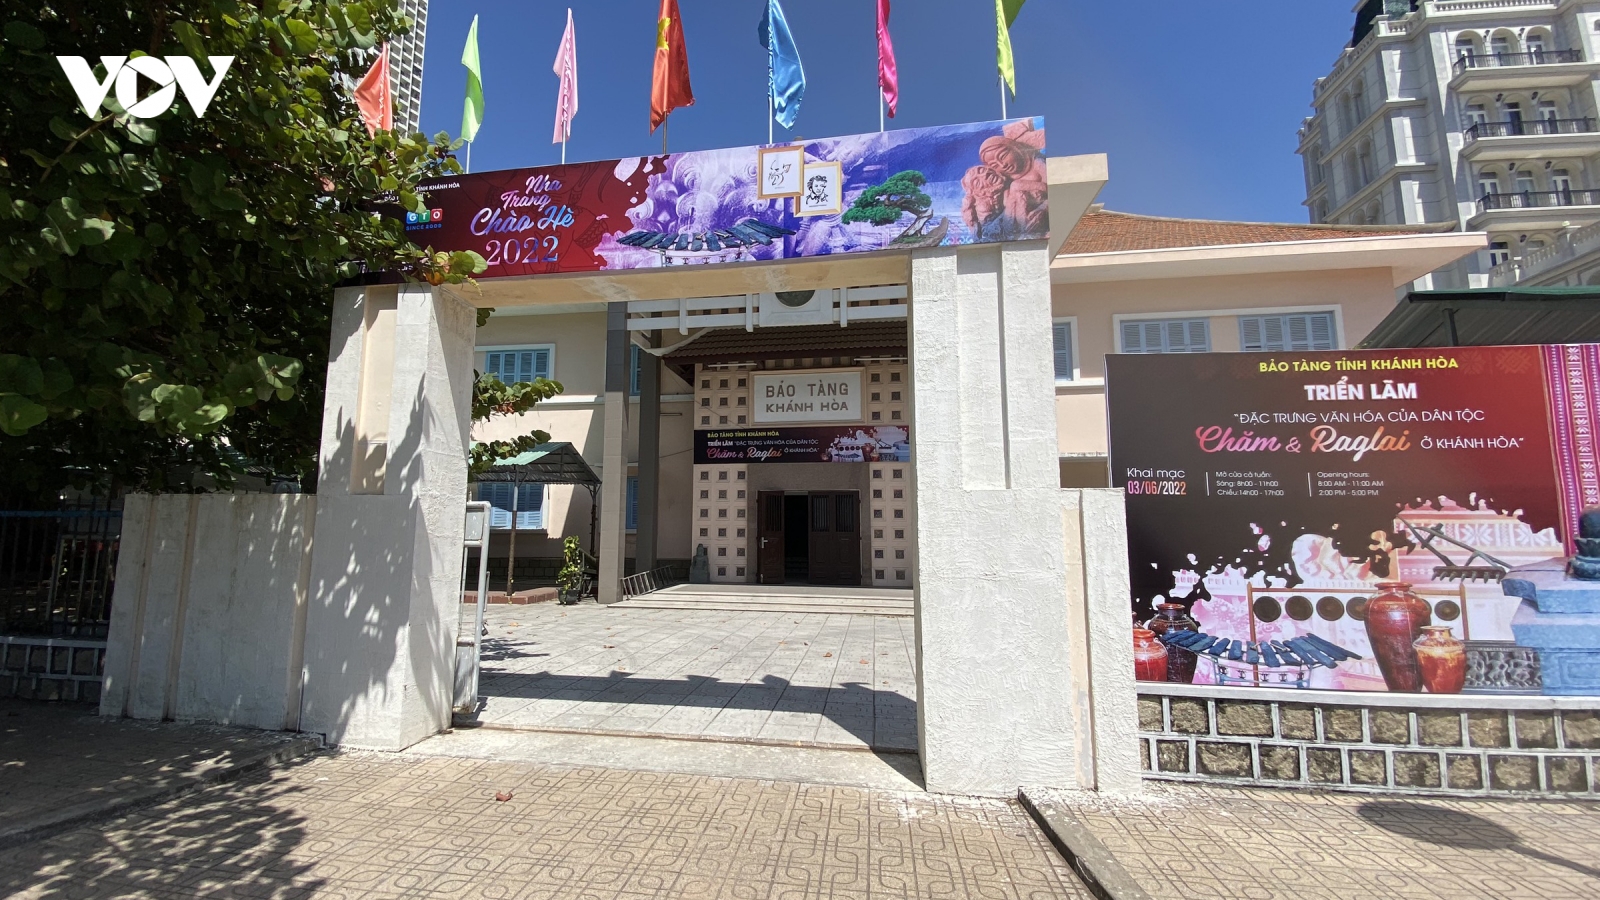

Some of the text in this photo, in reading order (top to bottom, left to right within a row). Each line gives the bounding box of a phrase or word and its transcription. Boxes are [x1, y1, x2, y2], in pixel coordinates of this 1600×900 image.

[525, 174, 562, 194] Nha
[500, 190, 551, 212] Trang
[470, 204, 575, 236] Chào Hè
[485, 235, 559, 266] 2022
[1259, 355, 1459, 372] BẢO TÀNG TỈNH KHÁNH HÒA
[807, 379, 849, 397] TÀNG
[1304, 375, 1418, 401] TRIỂN LÃM
[766, 398, 849, 413] KHÁNH HÒA
[1273, 412, 1317, 423] TRƯNG
[1320, 410, 1350, 423] VĂN
[1353, 409, 1385, 423] HÓA
[1388, 408, 1419, 422] CỦA
[1422, 409, 1453, 422] DÂN
[1455, 408, 1485, 423] TỘC
[1195, 425, 1282, 453] Chăm
[1285, 436, 1302, 453] &
[1310, 425, 1411, 462] Raglai
[1420, 435, 1434, 449] Ở
[1436, 436, 1484, 449] KHÁNH
[706, 447, 737, 459] Chăm
[746, 446, 783, 462] Raglai
[1126, 467, 1186, 480] Khai mạc
[1316, 471, 1348, 479] Opening
[1127, 480, 1187, 495] 03/06/2022
